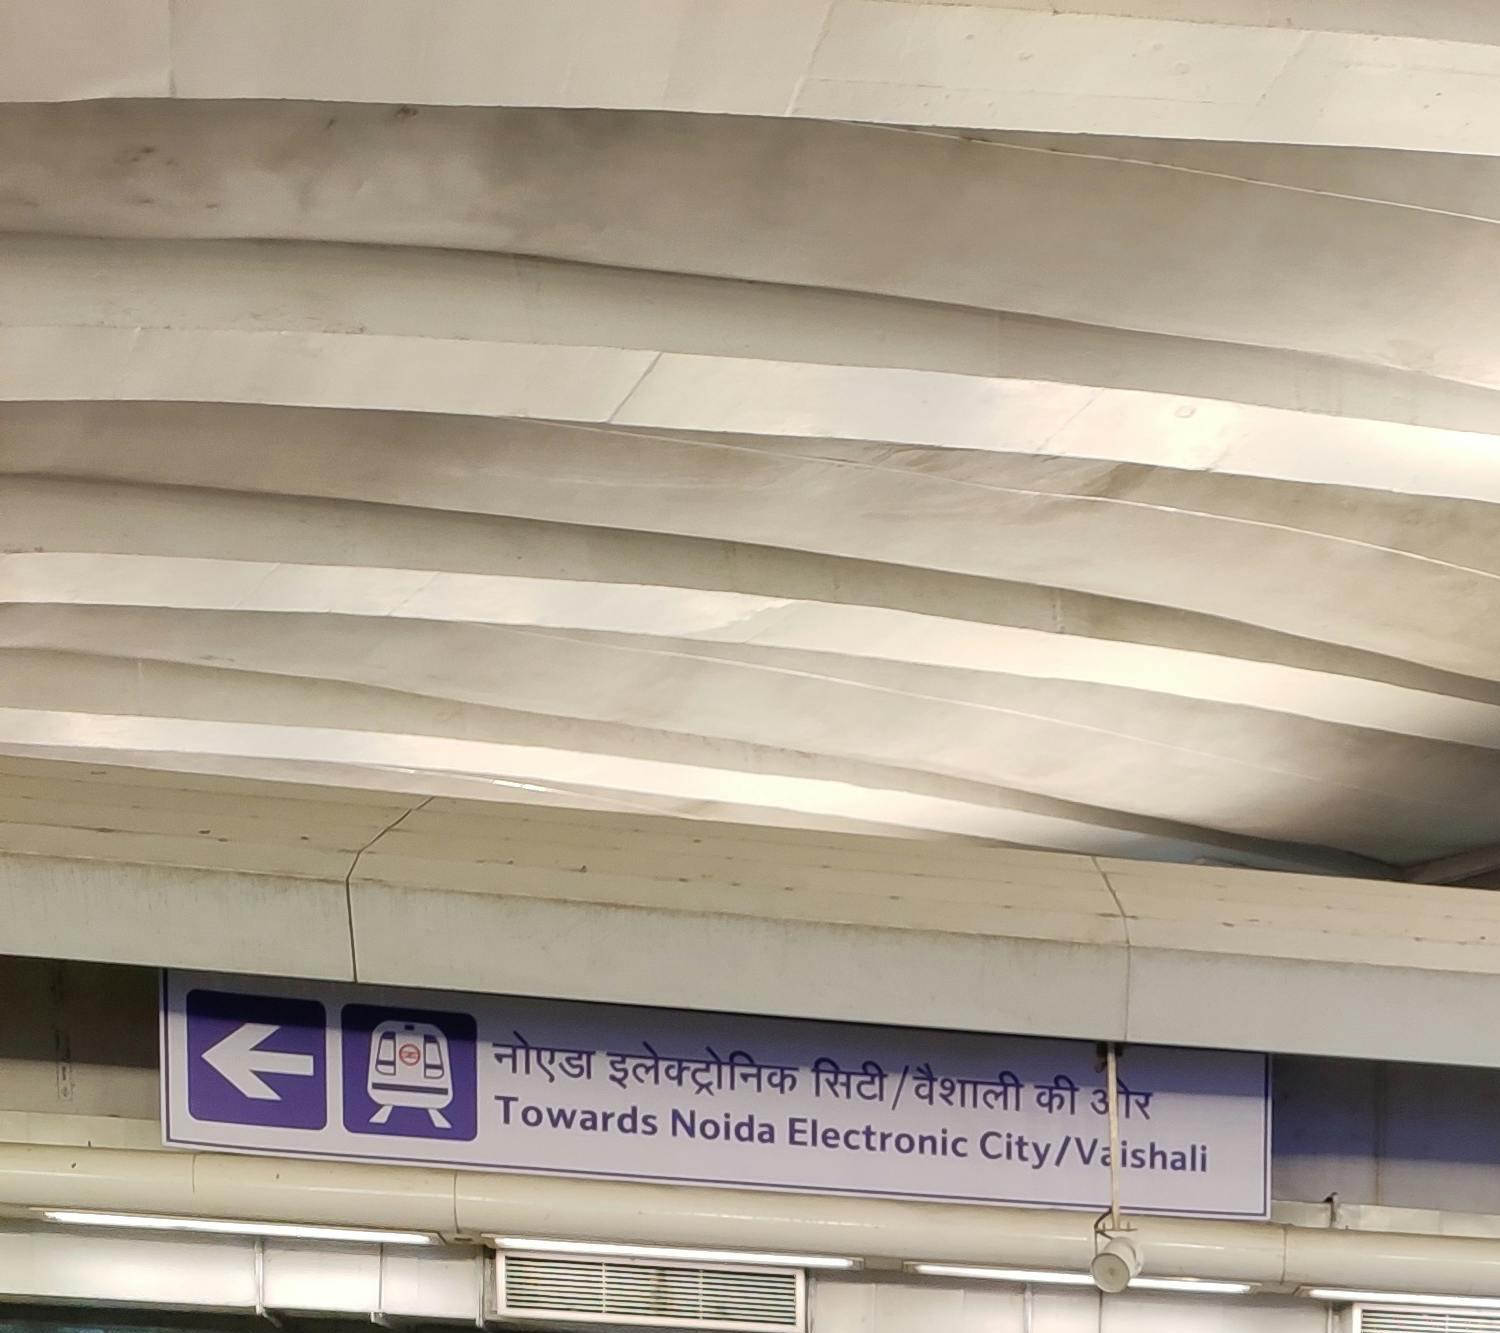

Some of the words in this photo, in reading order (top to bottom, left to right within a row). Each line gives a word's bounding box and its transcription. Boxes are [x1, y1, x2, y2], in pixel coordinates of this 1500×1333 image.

[493, 1030, 597, 1083] नोएडा
[1034, 1074, 1080, 1115] की
[494, 1095, 658, 1136] Towards
[671, 1108, 775, 1145] Noida
[788, 1117, 968, 1159] Electronic
